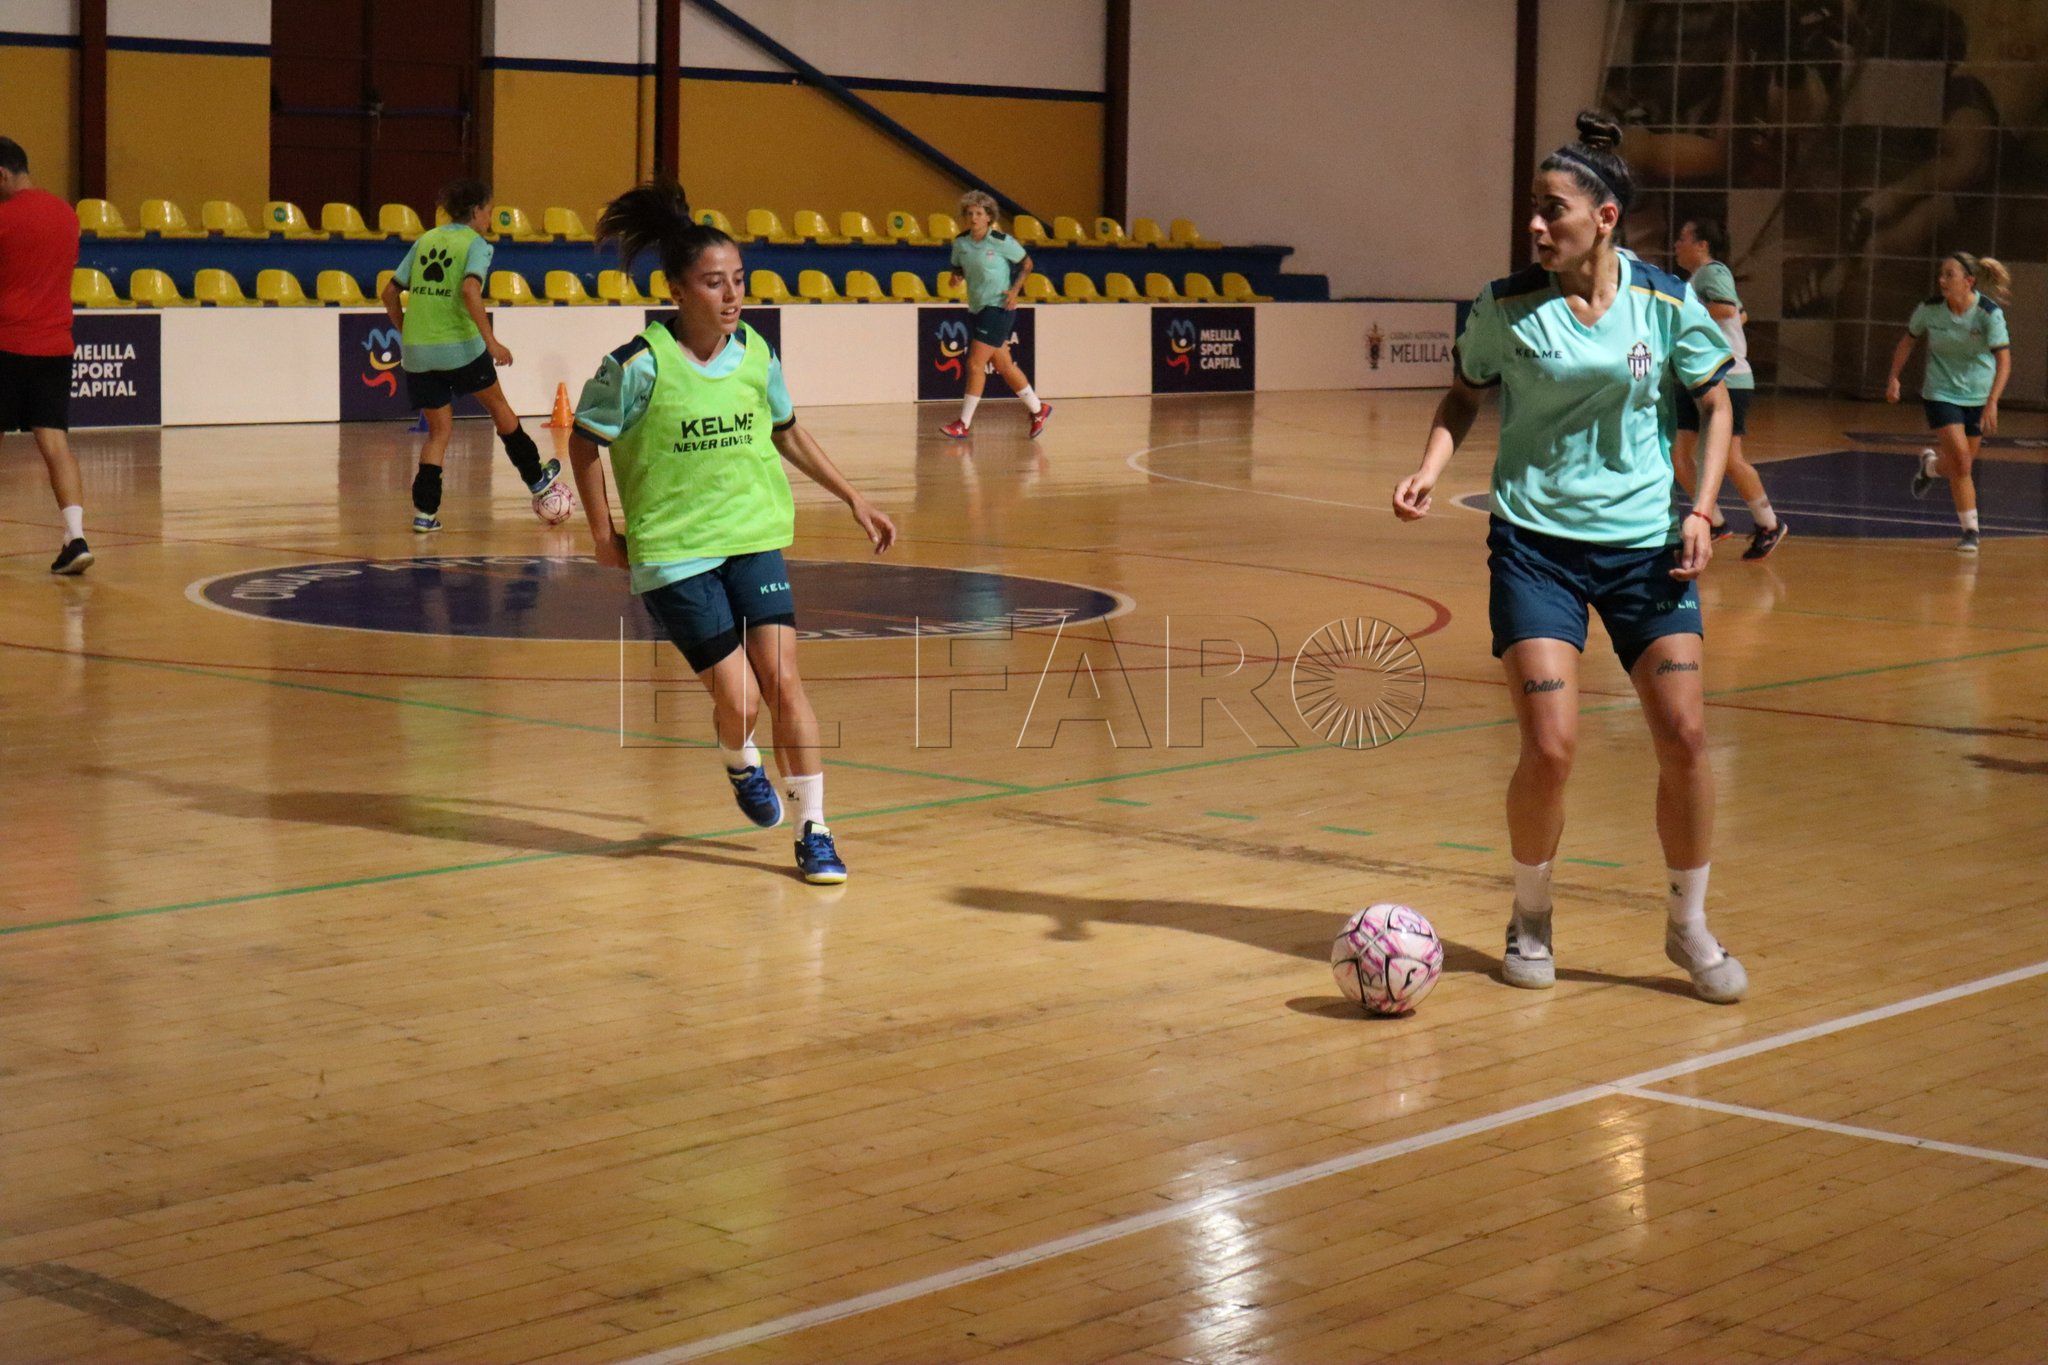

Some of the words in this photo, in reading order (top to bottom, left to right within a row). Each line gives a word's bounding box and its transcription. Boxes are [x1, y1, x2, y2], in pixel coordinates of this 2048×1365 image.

[412, 286, 452, 297] KELME
[1200, 329, 1241, 341] MELILLA
[1200, 343, 1234, 356] SPORT
[1391, 344, 1450, 363] MELILLA
[1515, 348, 1563, 359] KELME
[1200, 357, 1242, 370] CAPITAL
[673, 438, 717, 453] NEVER
